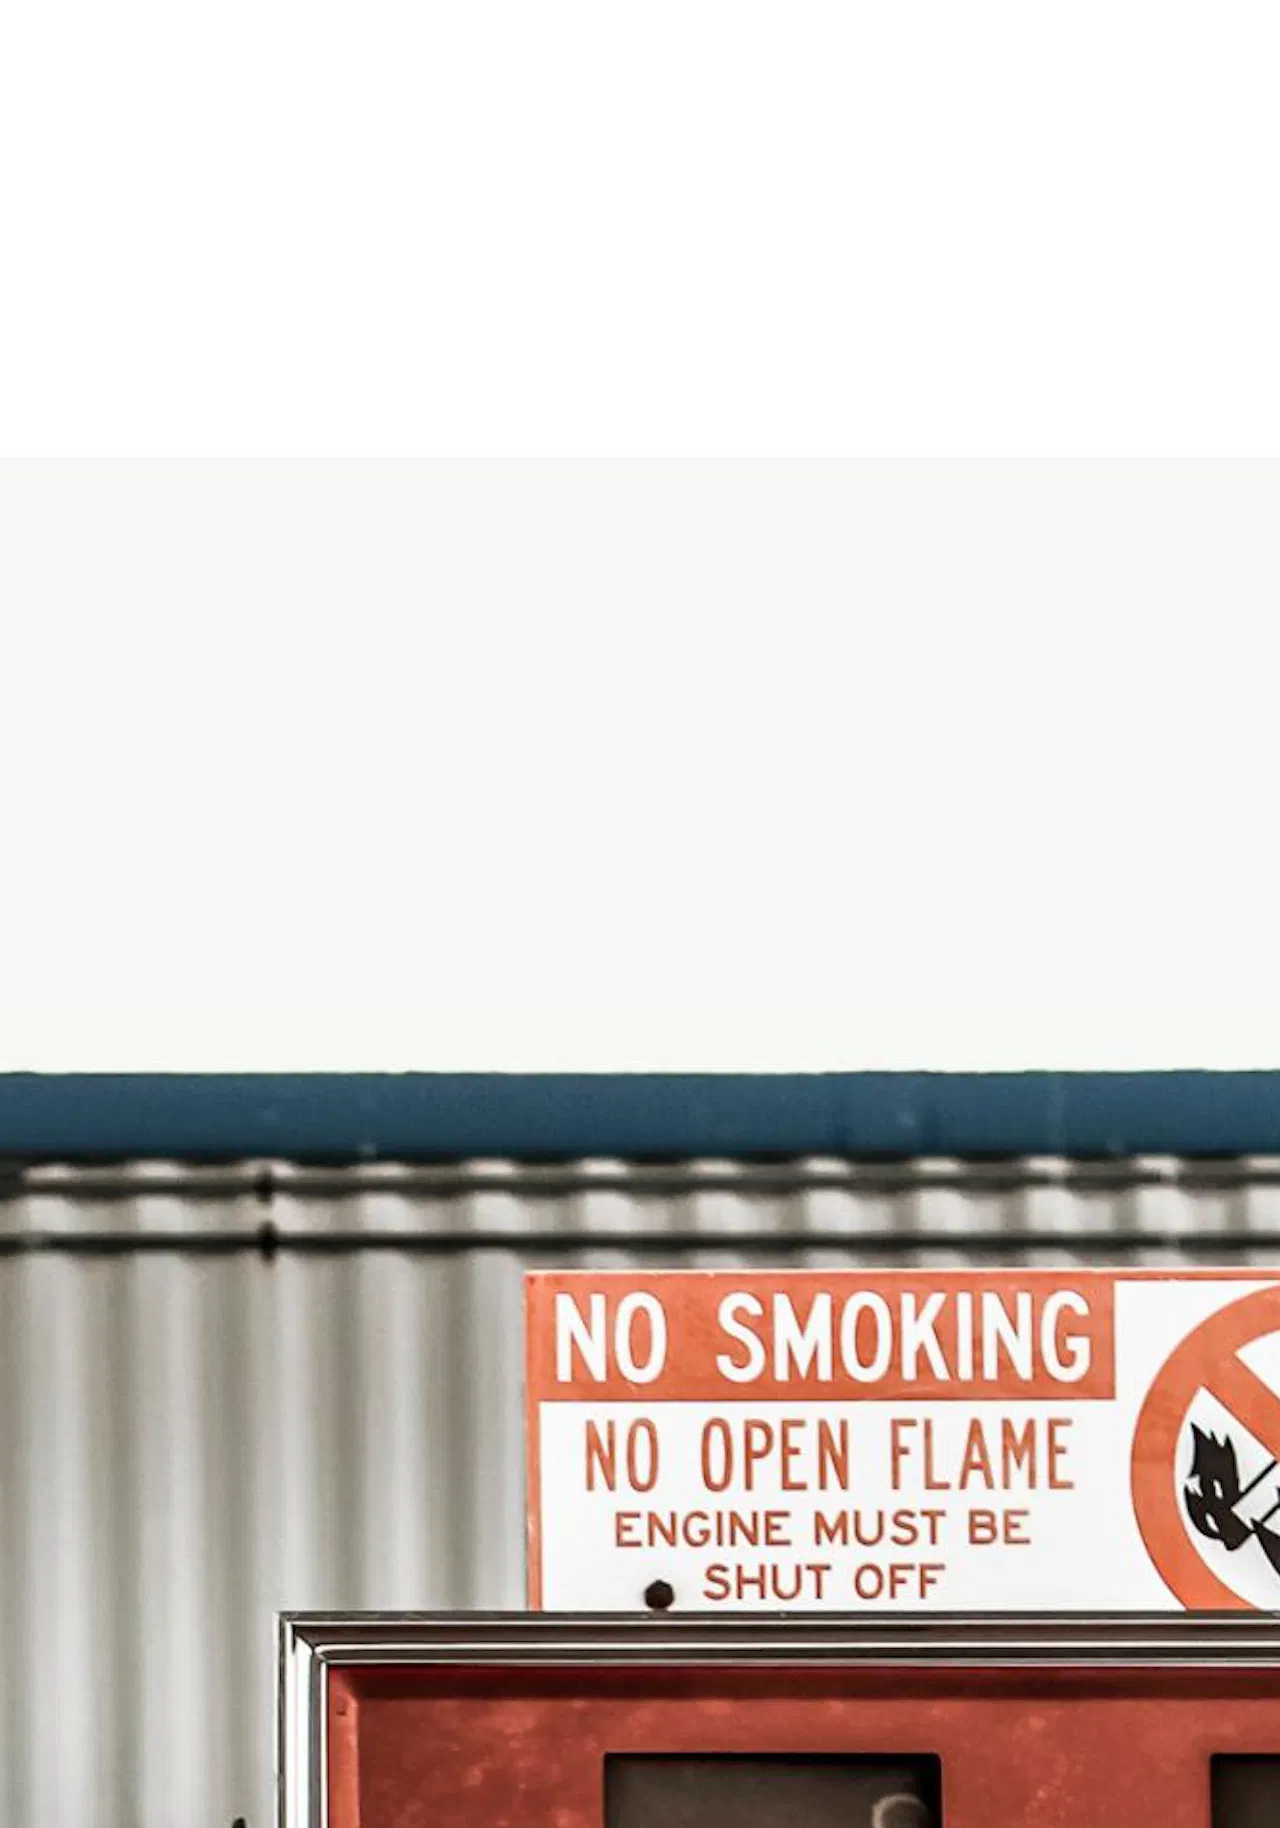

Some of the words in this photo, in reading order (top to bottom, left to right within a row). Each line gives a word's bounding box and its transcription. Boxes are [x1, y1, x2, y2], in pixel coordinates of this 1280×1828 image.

[554, 1290, 667, 1384] NO
[716, 1288, 1091, 1384] SMOKING
[585, 1418, 658, 1493] NO
[701, 1417, 850, 1493] OPEN
[890, 1418, 1074, 1492] FLAME
[614, 1510, 791, 1549] ENGINE
[813, 1508, 945, 1548] MUST
[969, 1507, 1031, 1546] BE
[702, 1562, 832, 1601] SHUT
[854, 1562, 946, 1600] OFF
